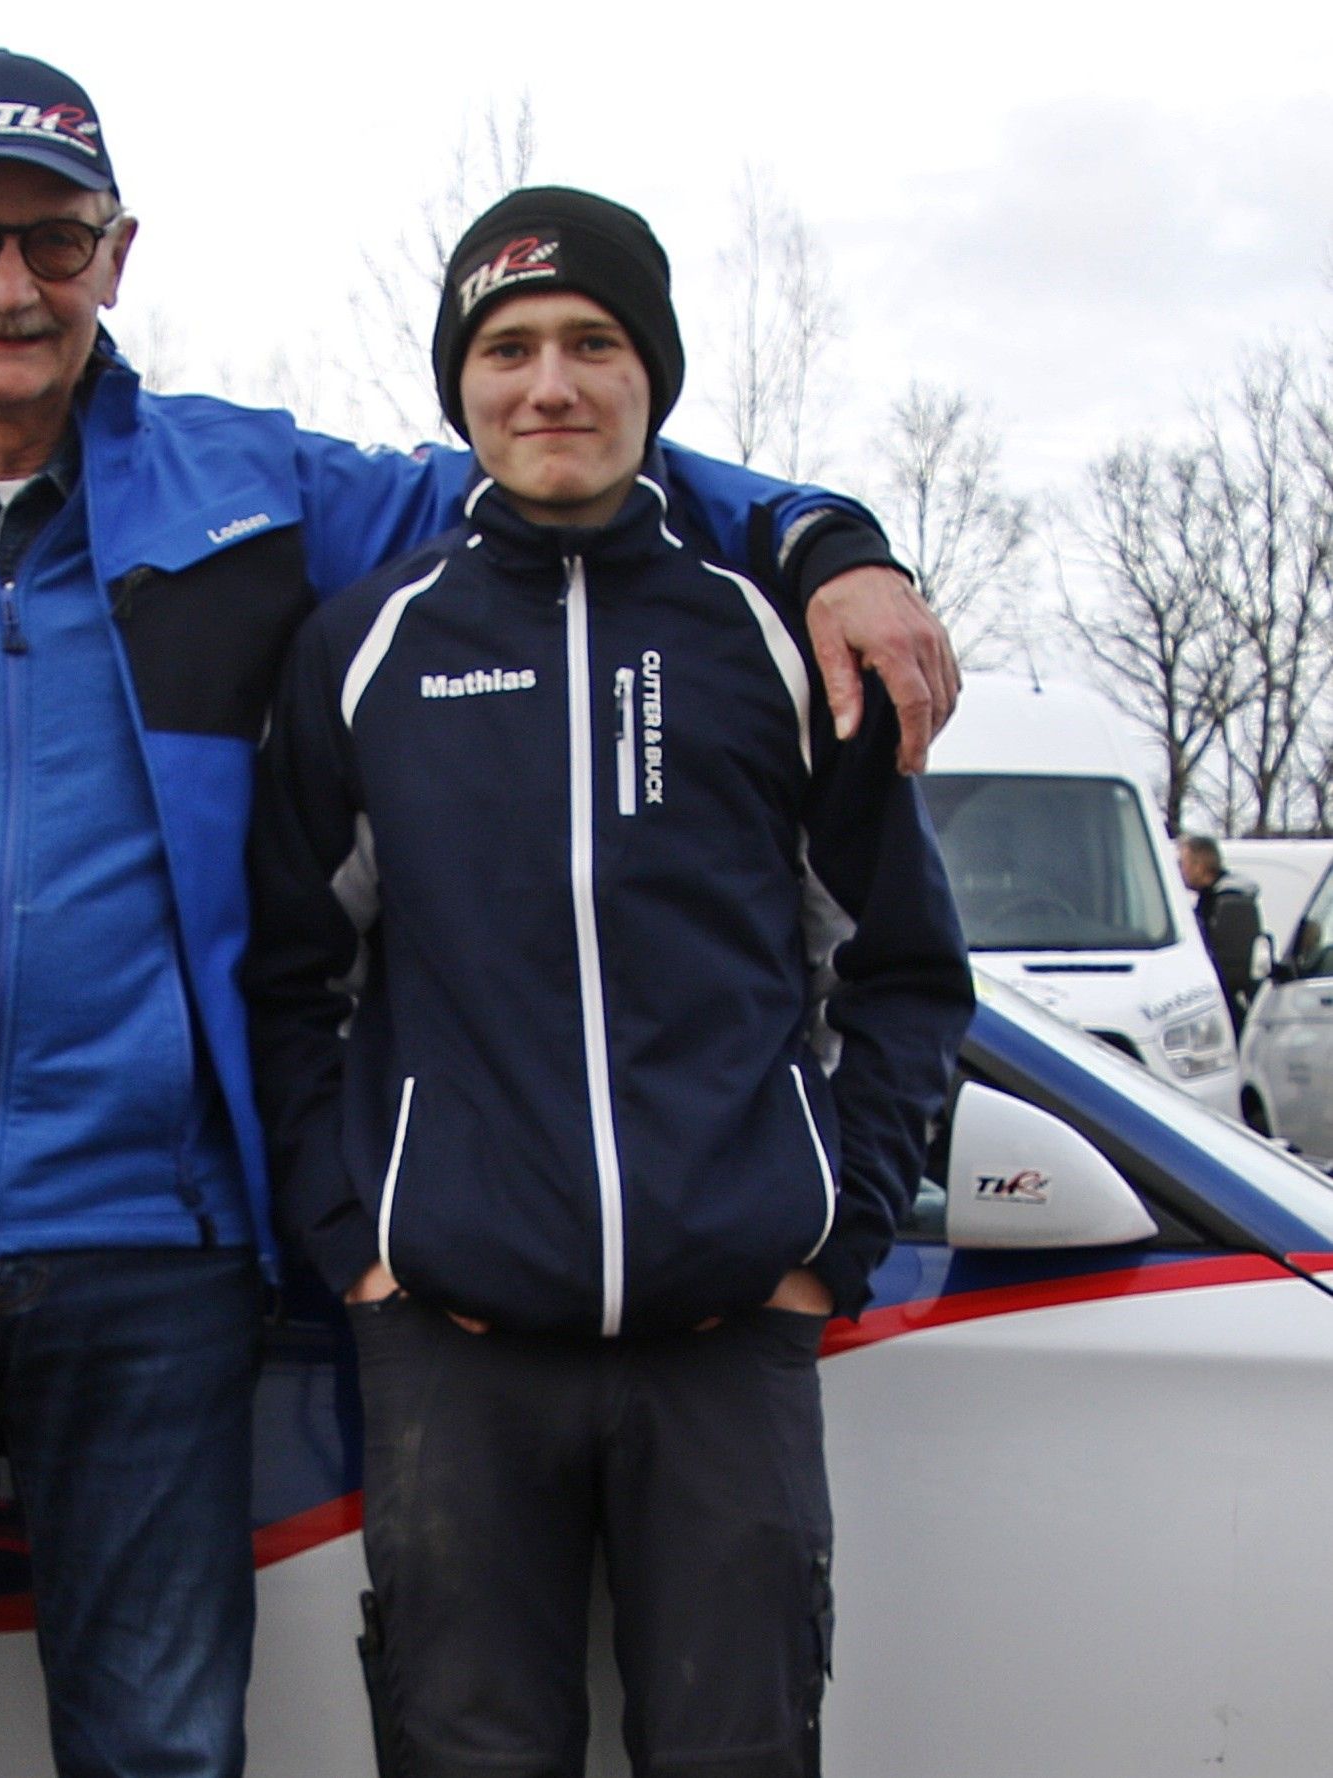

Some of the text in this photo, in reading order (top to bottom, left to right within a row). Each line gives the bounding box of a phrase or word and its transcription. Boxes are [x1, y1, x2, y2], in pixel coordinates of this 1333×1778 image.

[421, 668, 536, 698] Mathias
[642, 650, 664, 804] CUTTER & BUCK
